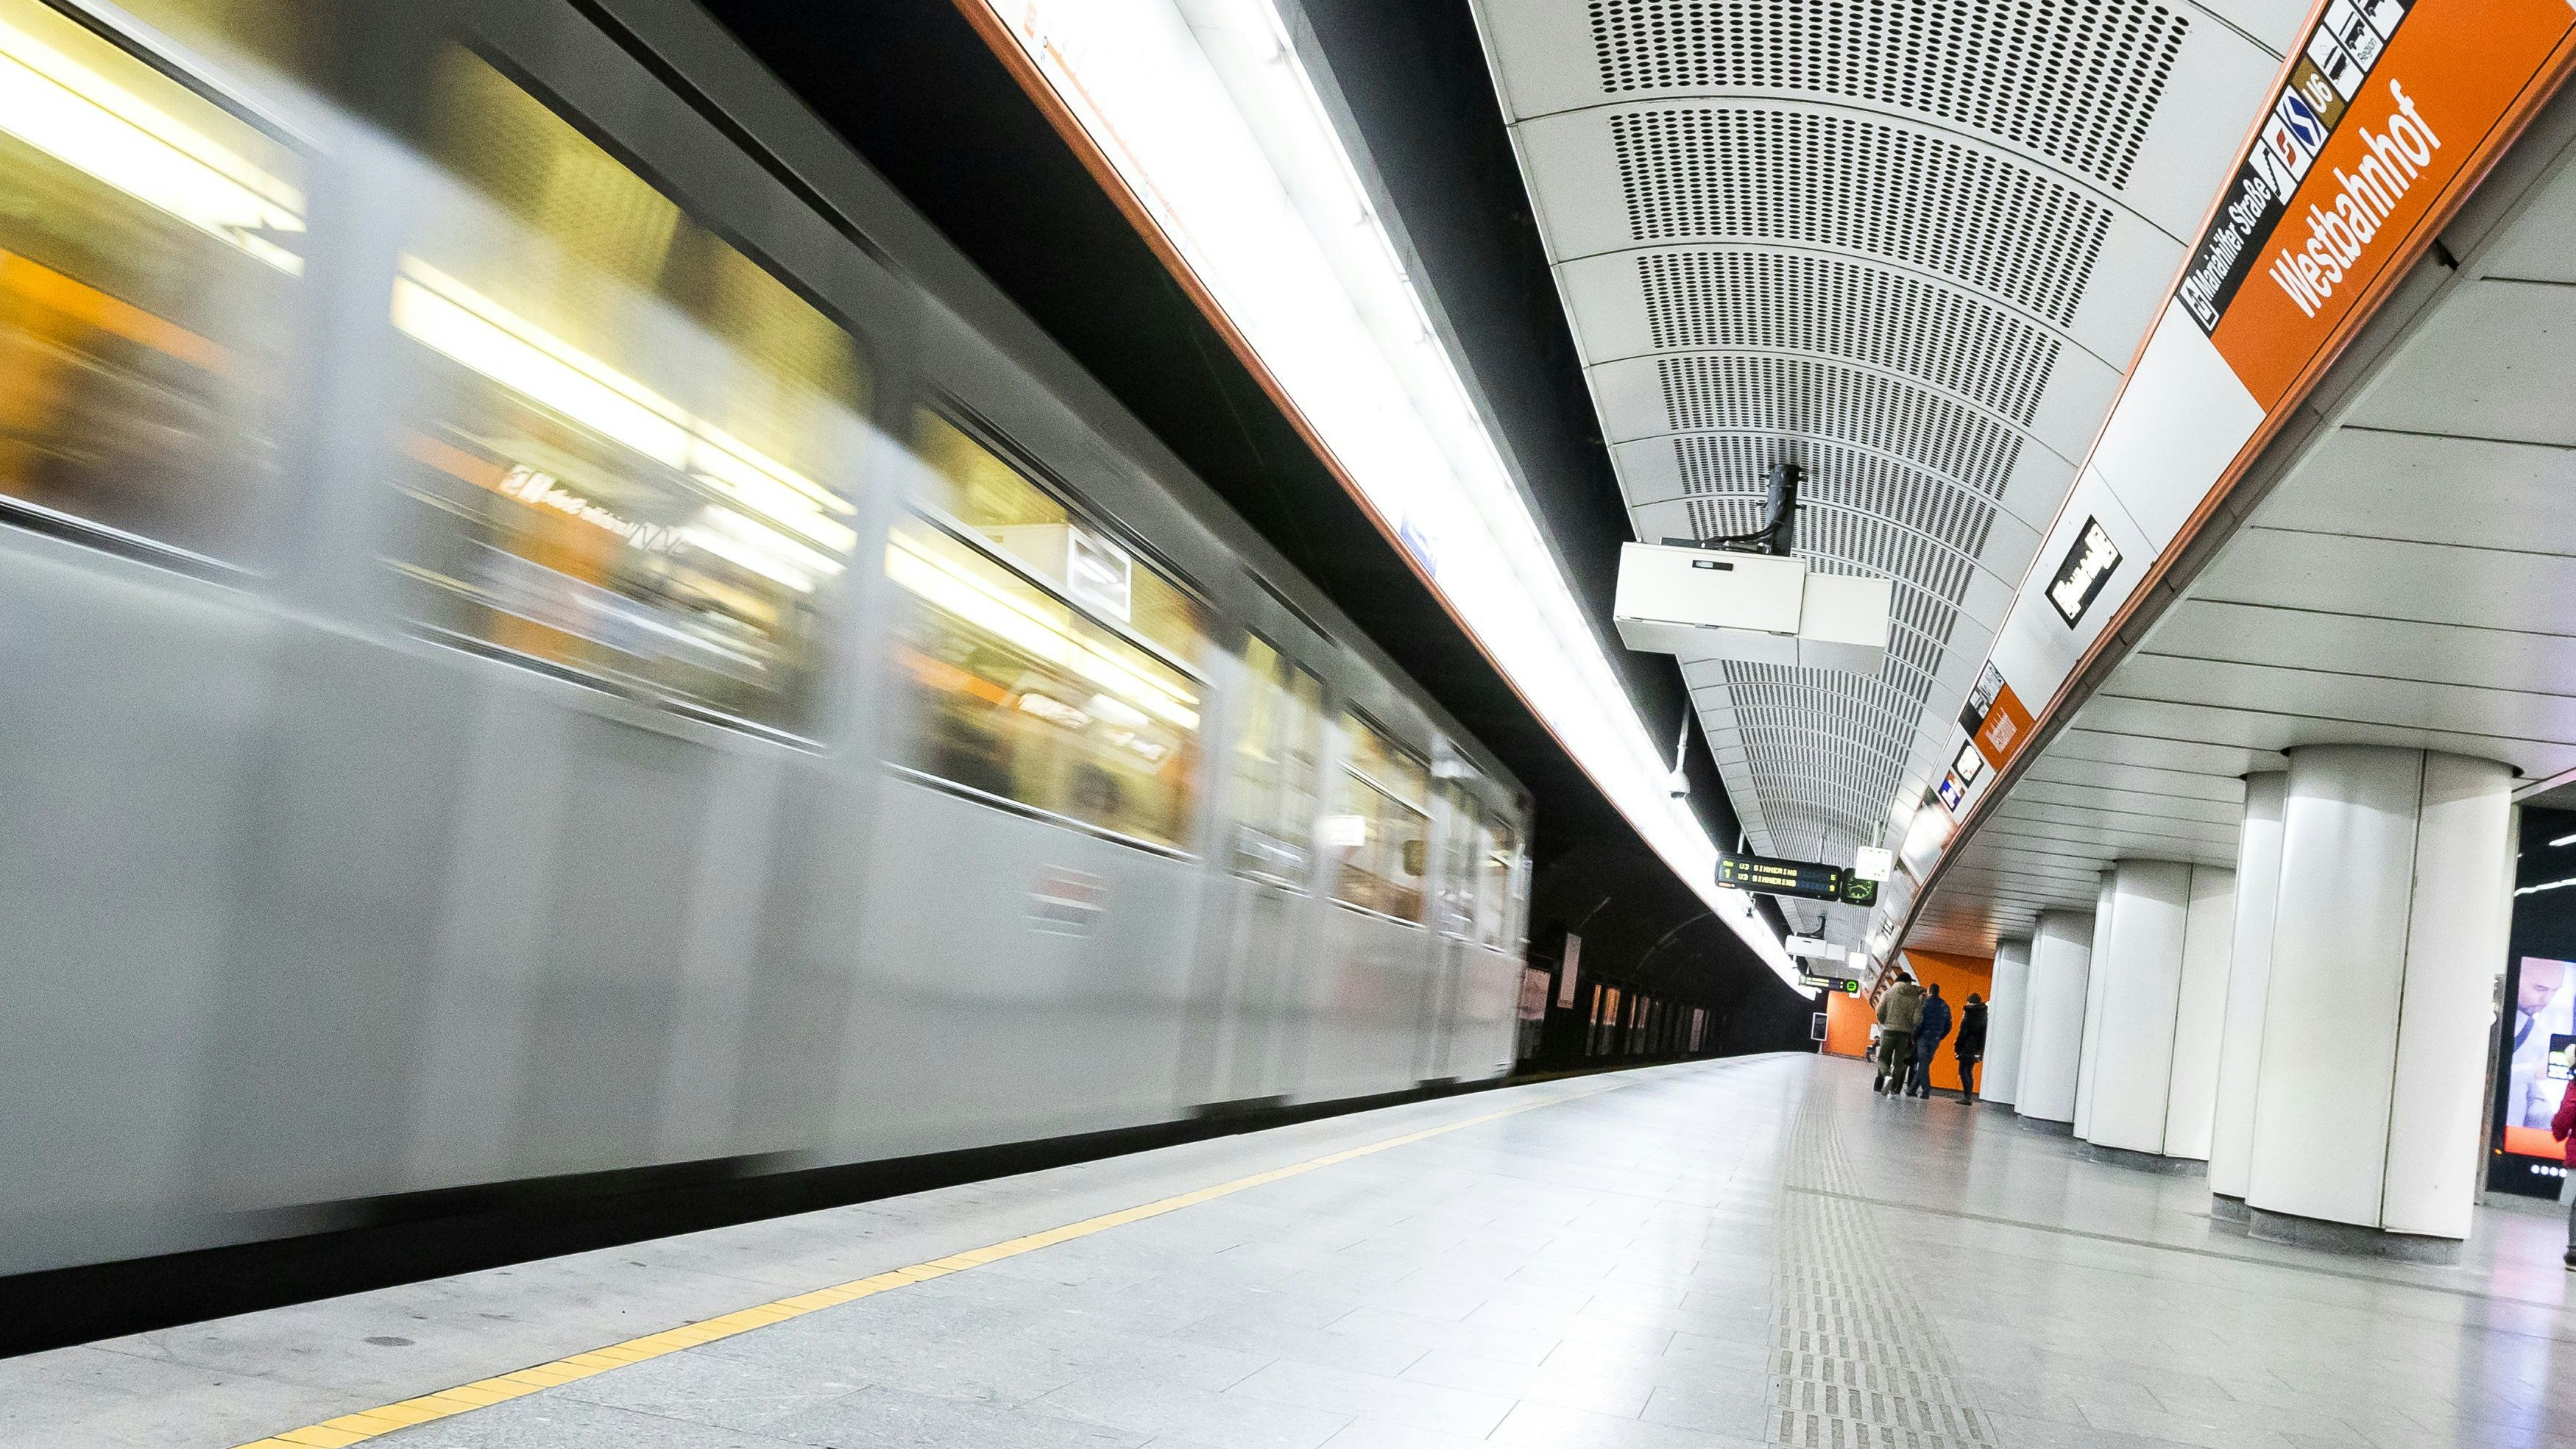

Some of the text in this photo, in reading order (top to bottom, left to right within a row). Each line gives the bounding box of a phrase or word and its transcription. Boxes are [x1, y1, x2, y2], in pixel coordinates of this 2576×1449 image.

[2301, 73, 2333, 113] U6
[2268, 78, 2441, 319] Westbahnhof
[2192, 177, 2271, 302] Mariahilfer Straße
[1738, 862, 1749, 871] U3
[1752, 864, 1797, 876] SIMMERING
[1738, 873, 1749, 881] U3
[1752, 875, 1796, 887] SIMMERING
